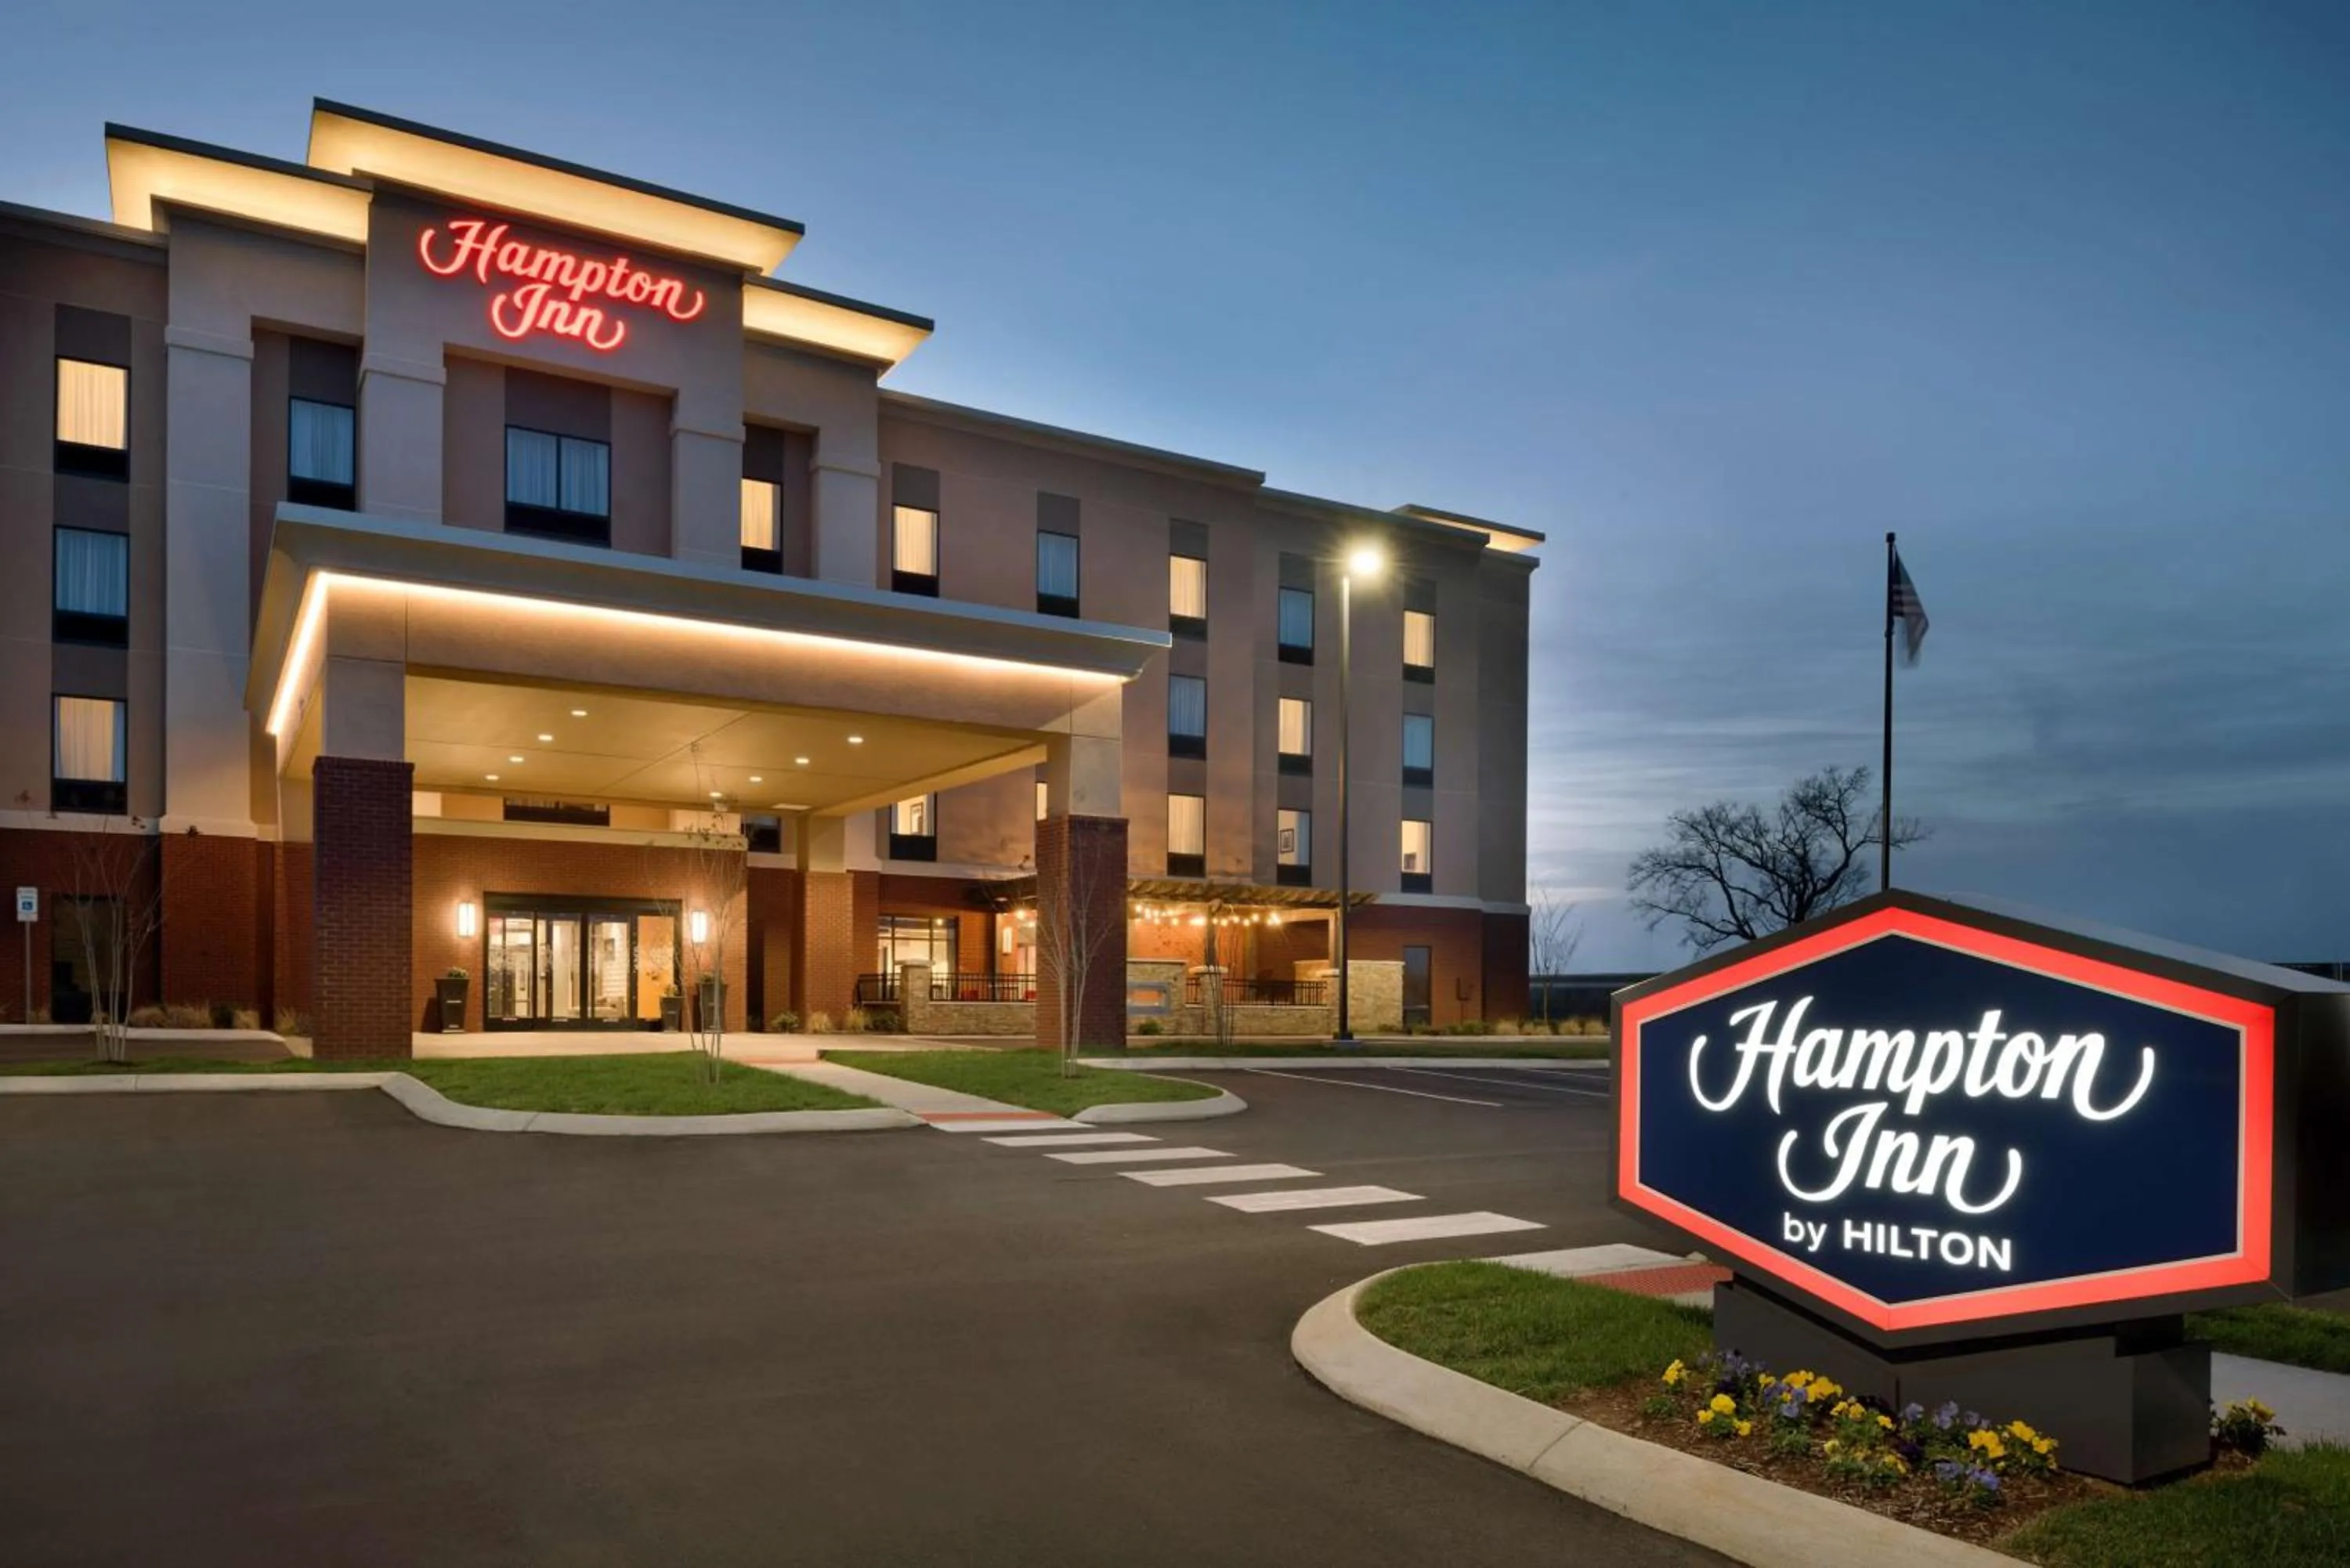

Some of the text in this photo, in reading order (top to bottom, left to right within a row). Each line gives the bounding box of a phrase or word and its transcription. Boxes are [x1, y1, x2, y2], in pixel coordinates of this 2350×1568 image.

[420, 221, 703, 320] Hampton
[491, 283, 625, 349] Inn
[1689, 995, 2156, 1121] Hampton
[1777, 1101, 2023, 1214] Inn
[1783, 1212, 2012, 1271] by HILTON
